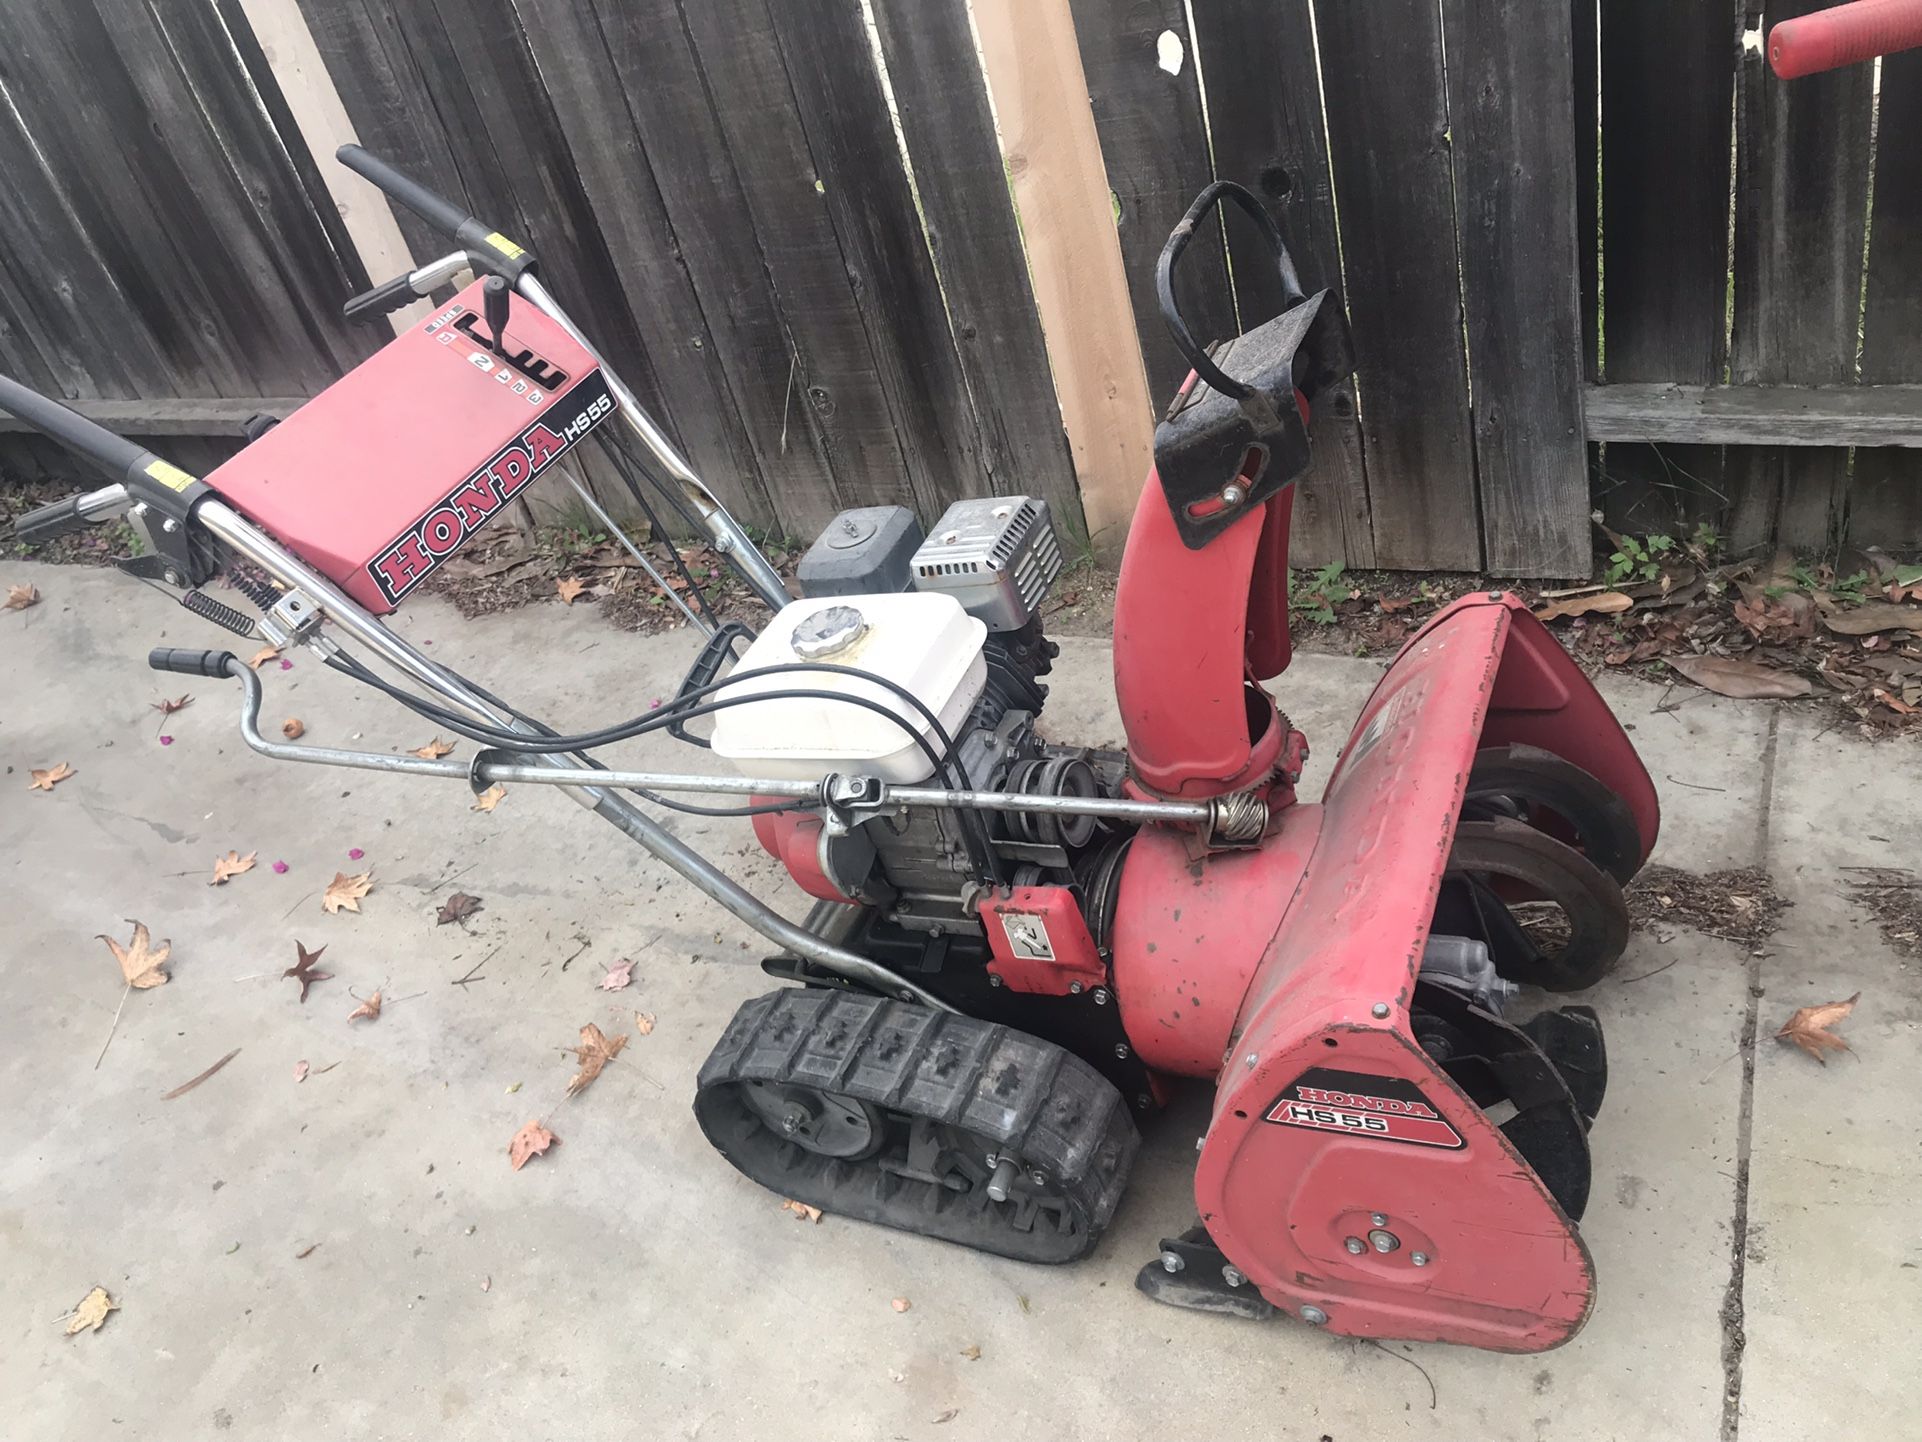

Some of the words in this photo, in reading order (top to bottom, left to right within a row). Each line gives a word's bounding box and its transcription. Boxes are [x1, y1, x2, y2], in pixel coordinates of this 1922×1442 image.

[474, 355, 490, 368] N
[512, 382, 526, 393] 2
[528, 393, 542, 404] 3
[376, 422, 568, 598] HONDA
[565, 394, 612, 442] HS55
[1296, 1086, 1438, 1118] HONDA
